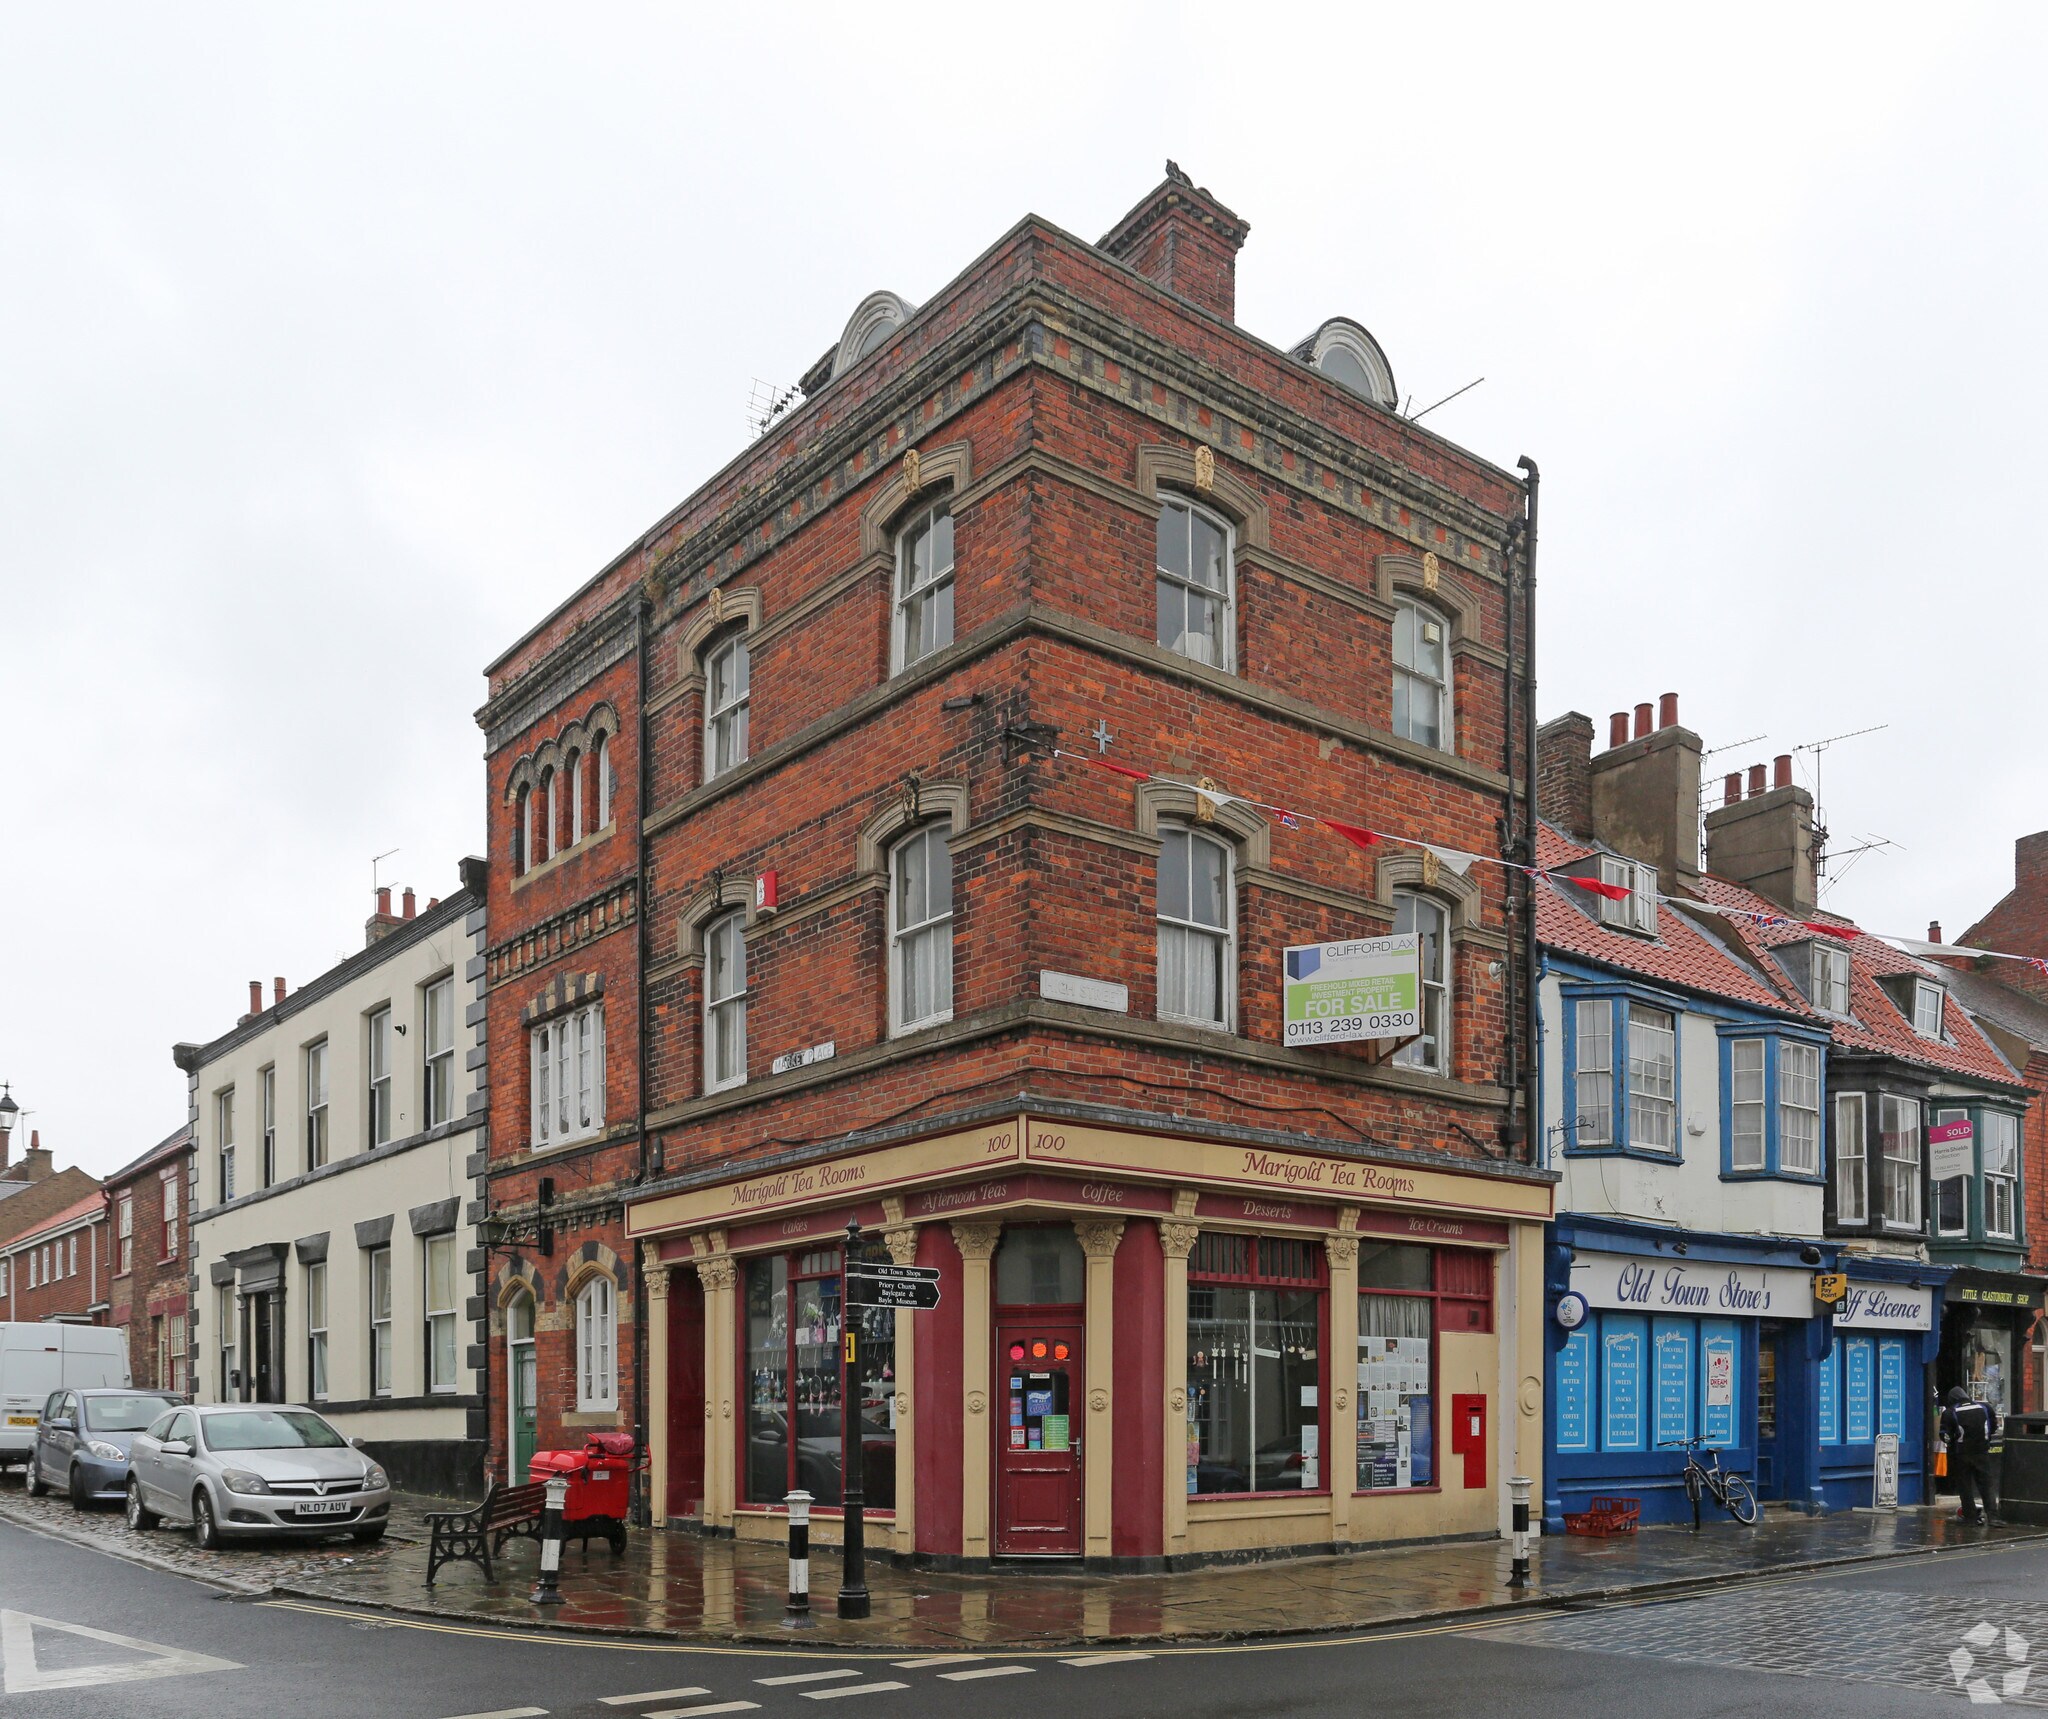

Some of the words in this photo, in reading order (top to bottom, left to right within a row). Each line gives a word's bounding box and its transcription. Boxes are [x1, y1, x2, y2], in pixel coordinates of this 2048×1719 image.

[1326, 938, 1415, 958] CLIFFORDLAX
[1310, 982, 1348, 992] FREEHOLD
[1350, 980, 1370, 988] MIXED
[1372, 977, 1396, 986] RETAIL
[1312, 988, 1354, 999] INVESTMENT
[1356, 984, 1394, 995] PROPERTY
[1080, 986, 1124, 1004] STREET
[1306, 998, 1345, 1018] FOR
[1350, 992, 1402, 1014] SALE
[1288, 1022, 1323, 1036] 0113
[1330, 1018, 1362, 1032] 239
[1370, 1012, 1414, 1028] 0330
[1289, 1028, 1390, 1044] www.clifford-lax.co.uk
[775, 1053, 805, 1072] MARKET
[808, 1045, 832, 1062] PACE
[1946, 1126, 1970, 1137] SOLD
[986, 1134, 1011, 1153] 100
[1036, 1134, 1066, 1150] 100
[1242, 1152, 1326, 1183] Marigold
[1330, 1163, 1356, 1186] Tea
[1362, 1167, 1414, 1193] Rooms
[731, 1175, 788, 1205] Marigold
[792, 1170, 813, 1194] Tea
[819, 1164, 866, 1188] Rooms
[1082, 1183, 1124, 1202] Coffee
[922, 1189, 976, 1212] Afternoon
[980, 1182, 1007, 1200] Teas
[1243, 1200, 1292, 1219] Desserts
[782, 1217, 808, 1234] Cakes
[1408, 1217, 1424, 1232] Ice
[1426, 1218, 1464, 1235] Creams
[890, 1268, 903, 1276] Town
[878, 1282, 894, 1290] Priory
[898, 1282, 916, 1290] Church
[1616, 1262, 1656, 1303] Old
[1661, 1266, 1710, 1307] Town
[882, 1290, 906, 1298] Baylegate
[1962, 1288, 1978, 1300] LITTLE
[1982, 1290, 2013, 1304] GLASTONBURY
[2017, 1294, 2030, 1304] SHOP
[1864, 1290, 1921, 1319] Licence
[1710, 1378, 1728, 1386] DREAM
[300, 1503, 326, 1513] NL07
